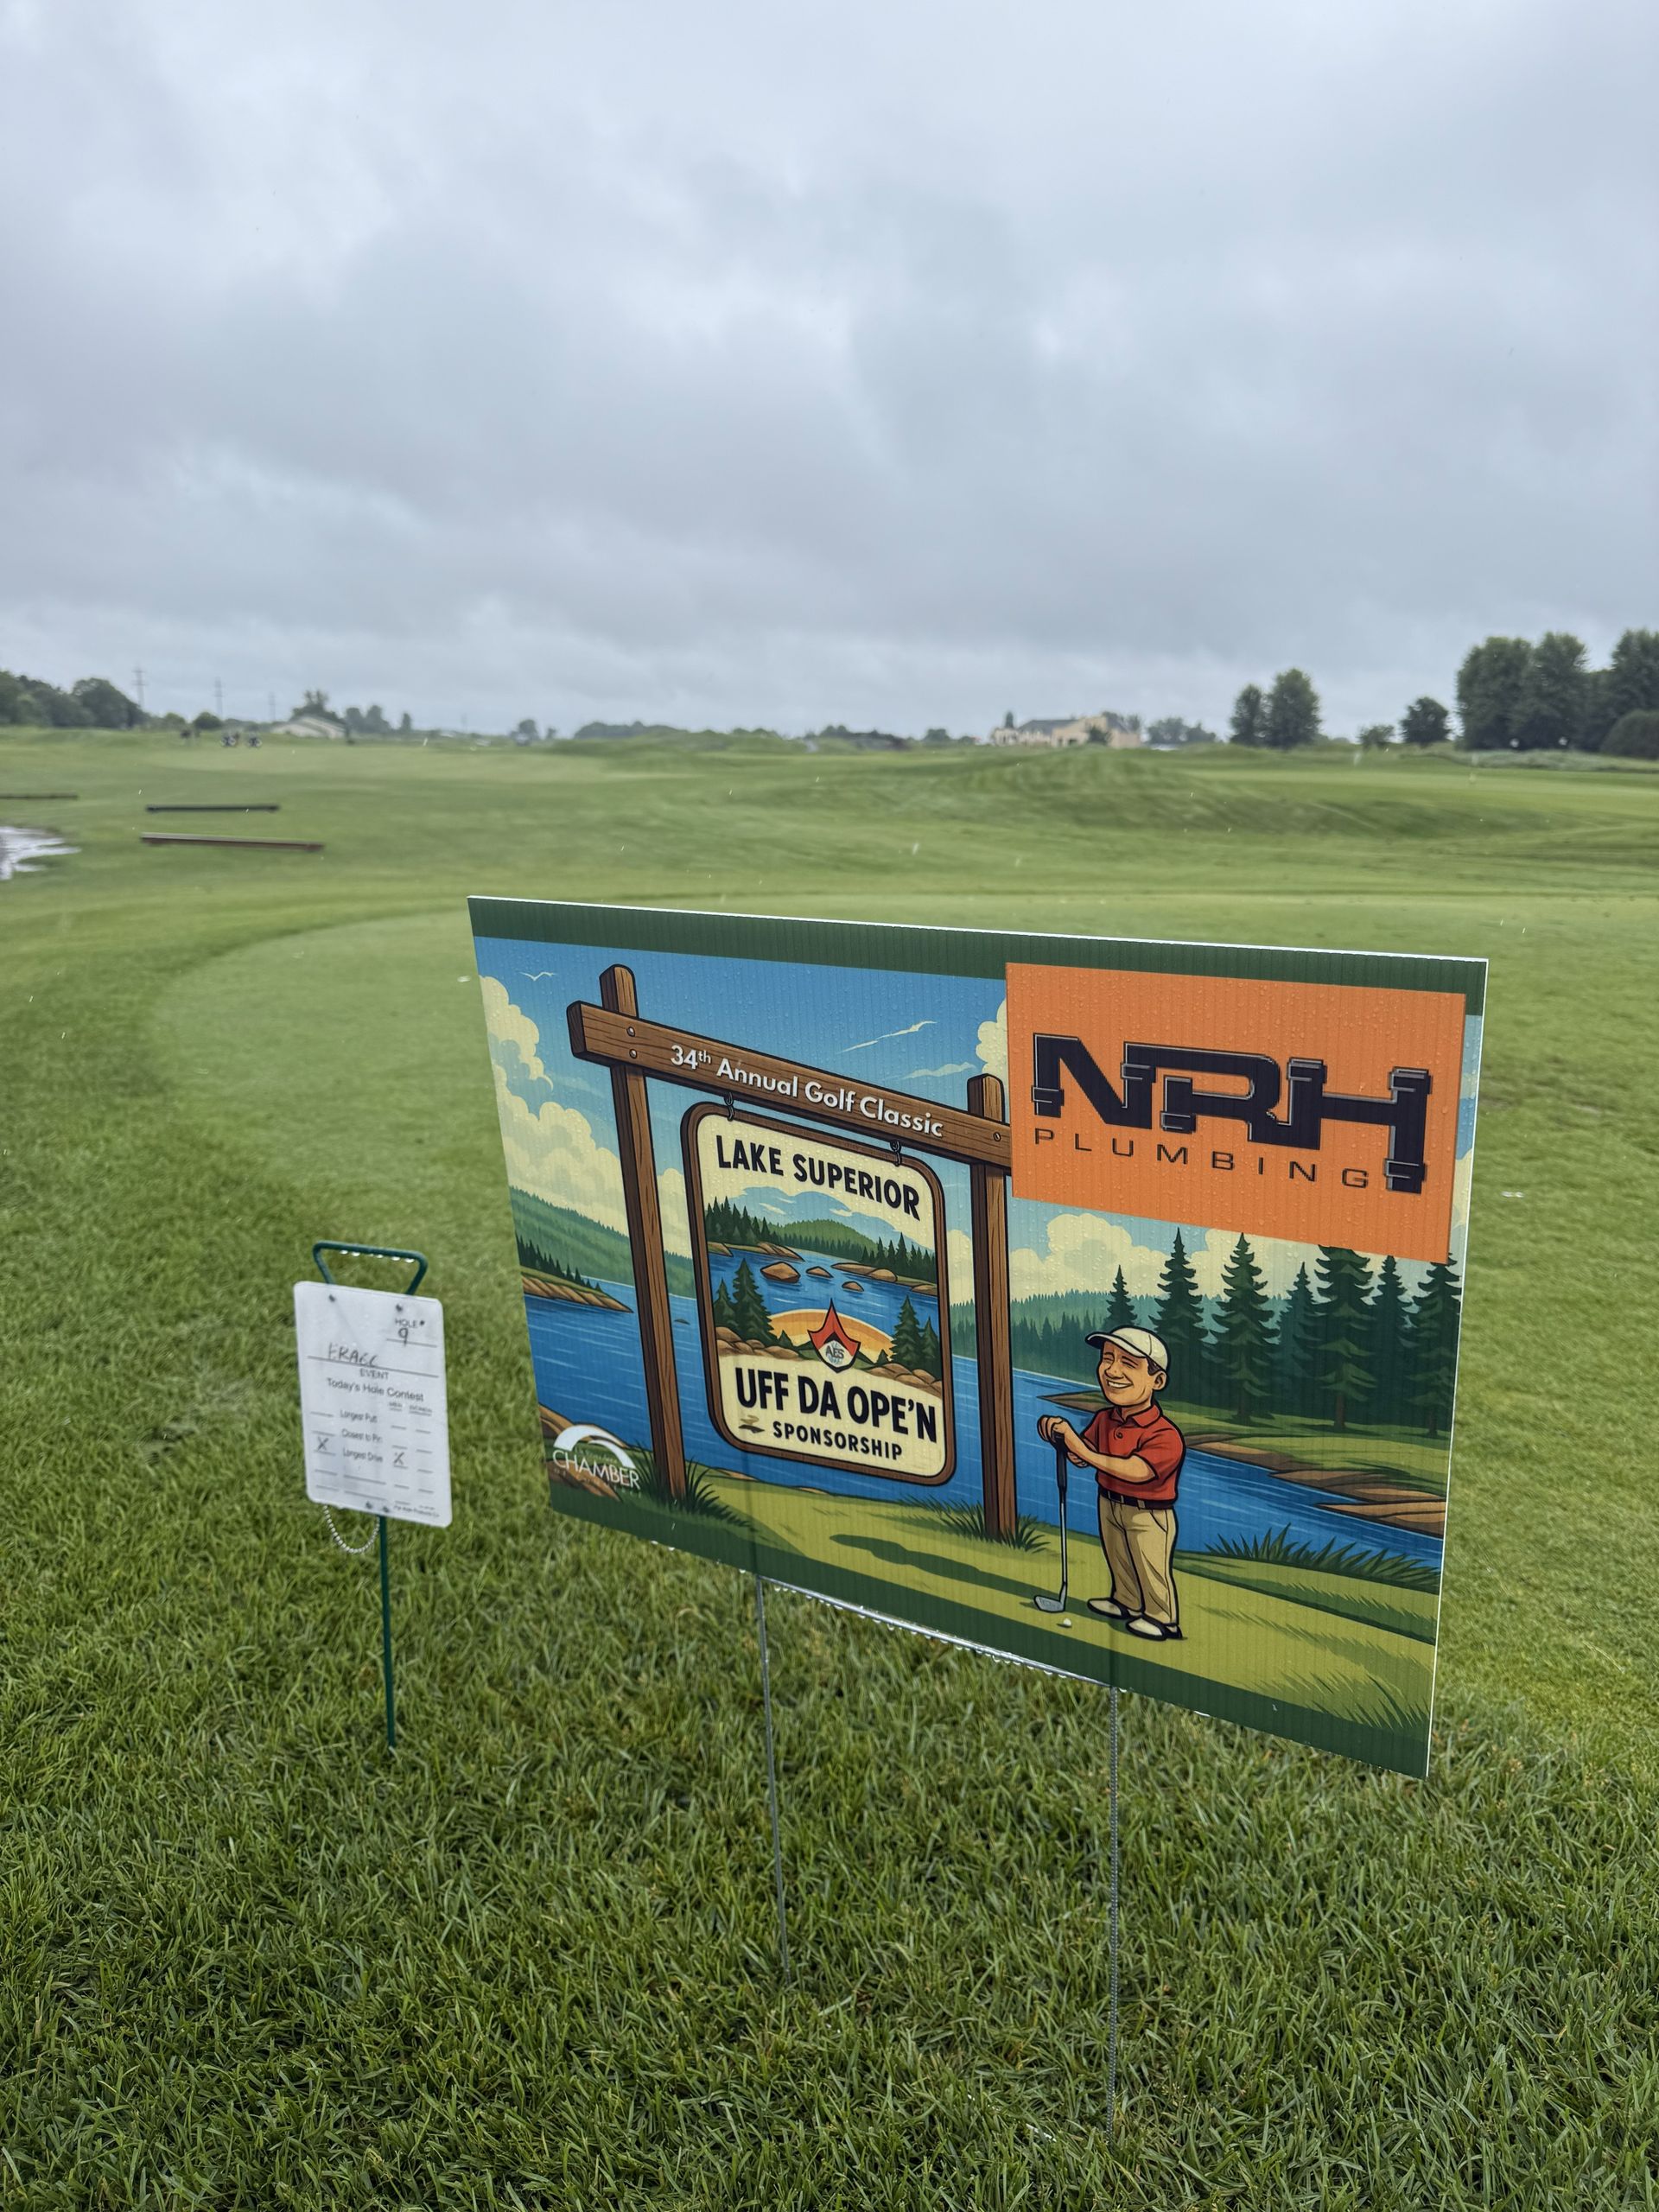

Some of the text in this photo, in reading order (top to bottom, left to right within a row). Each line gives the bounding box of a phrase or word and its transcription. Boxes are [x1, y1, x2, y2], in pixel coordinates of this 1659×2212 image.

[715, 1058, 798, 1098] Annual
[804, 1081, 855, 1113] Golf
[859, 1096, 944, 1138] Classic
[1032, 1033, 1433, 1195] NRH
[715, 1135, 921, 1221] LAKE SUPERIOR
[1034, 1128, 1369, 1189] PLUMBING
[397, 1327, 409, 1347] 9
[327, 1377, 424, 1402] Today's Hole Contest
[359, 1368, 389, 1380] EVENT
[735, 1367, 938, 1444] UFF DA OPE'N
[773, 1421, 903, 1461] SPONSORSHIP
[552, 1449, 641, 1491] CHAMBER
